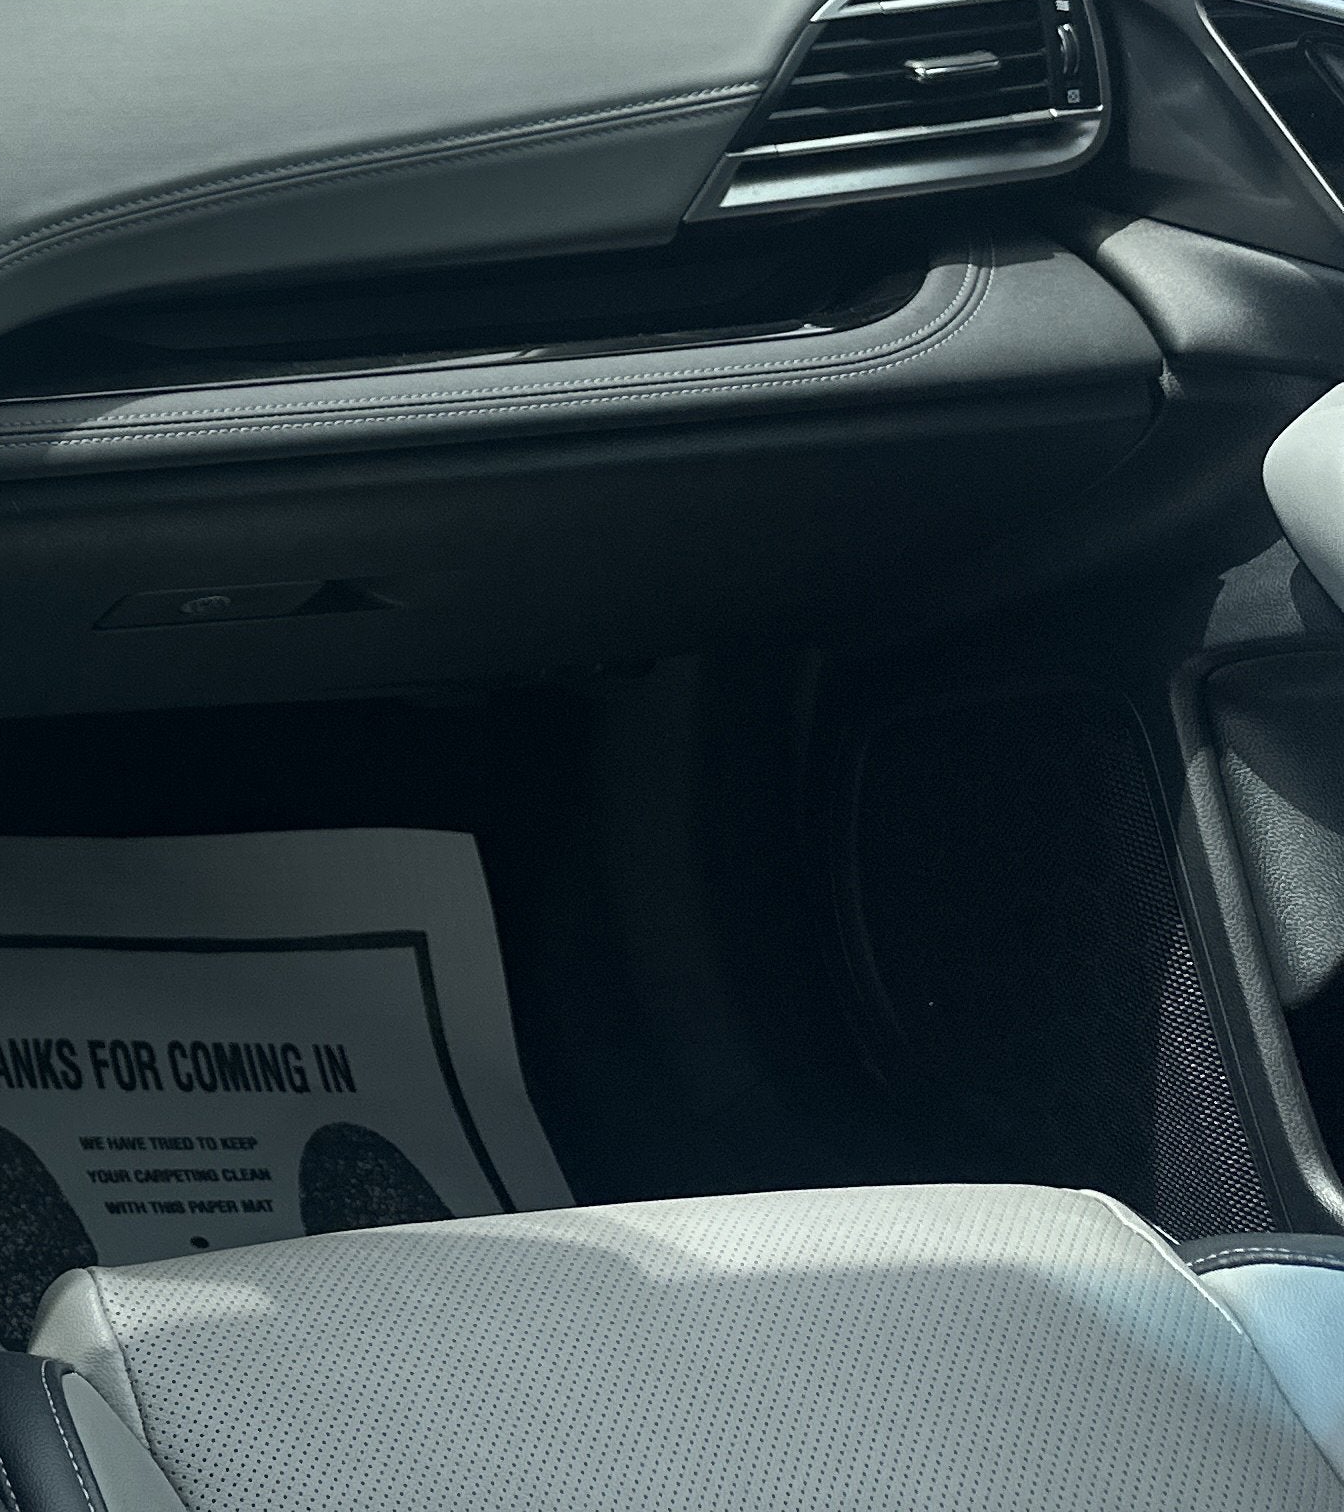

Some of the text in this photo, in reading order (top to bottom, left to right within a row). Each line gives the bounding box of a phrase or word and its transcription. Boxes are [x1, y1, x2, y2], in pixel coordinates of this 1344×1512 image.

[86, 1039, 164, 1092] FOR
[167, 1040, 311, 1094] COMING
[312, 1044, 358, 1094] IN
[79, 1136, 258, 1150] WE HAVE TRIED TO KEEP
[87, 1168, 272, 1184] YOUR CARPETING CLEAN
[104, 1199, 272, 1214] WITH THIS PAPER MAT
